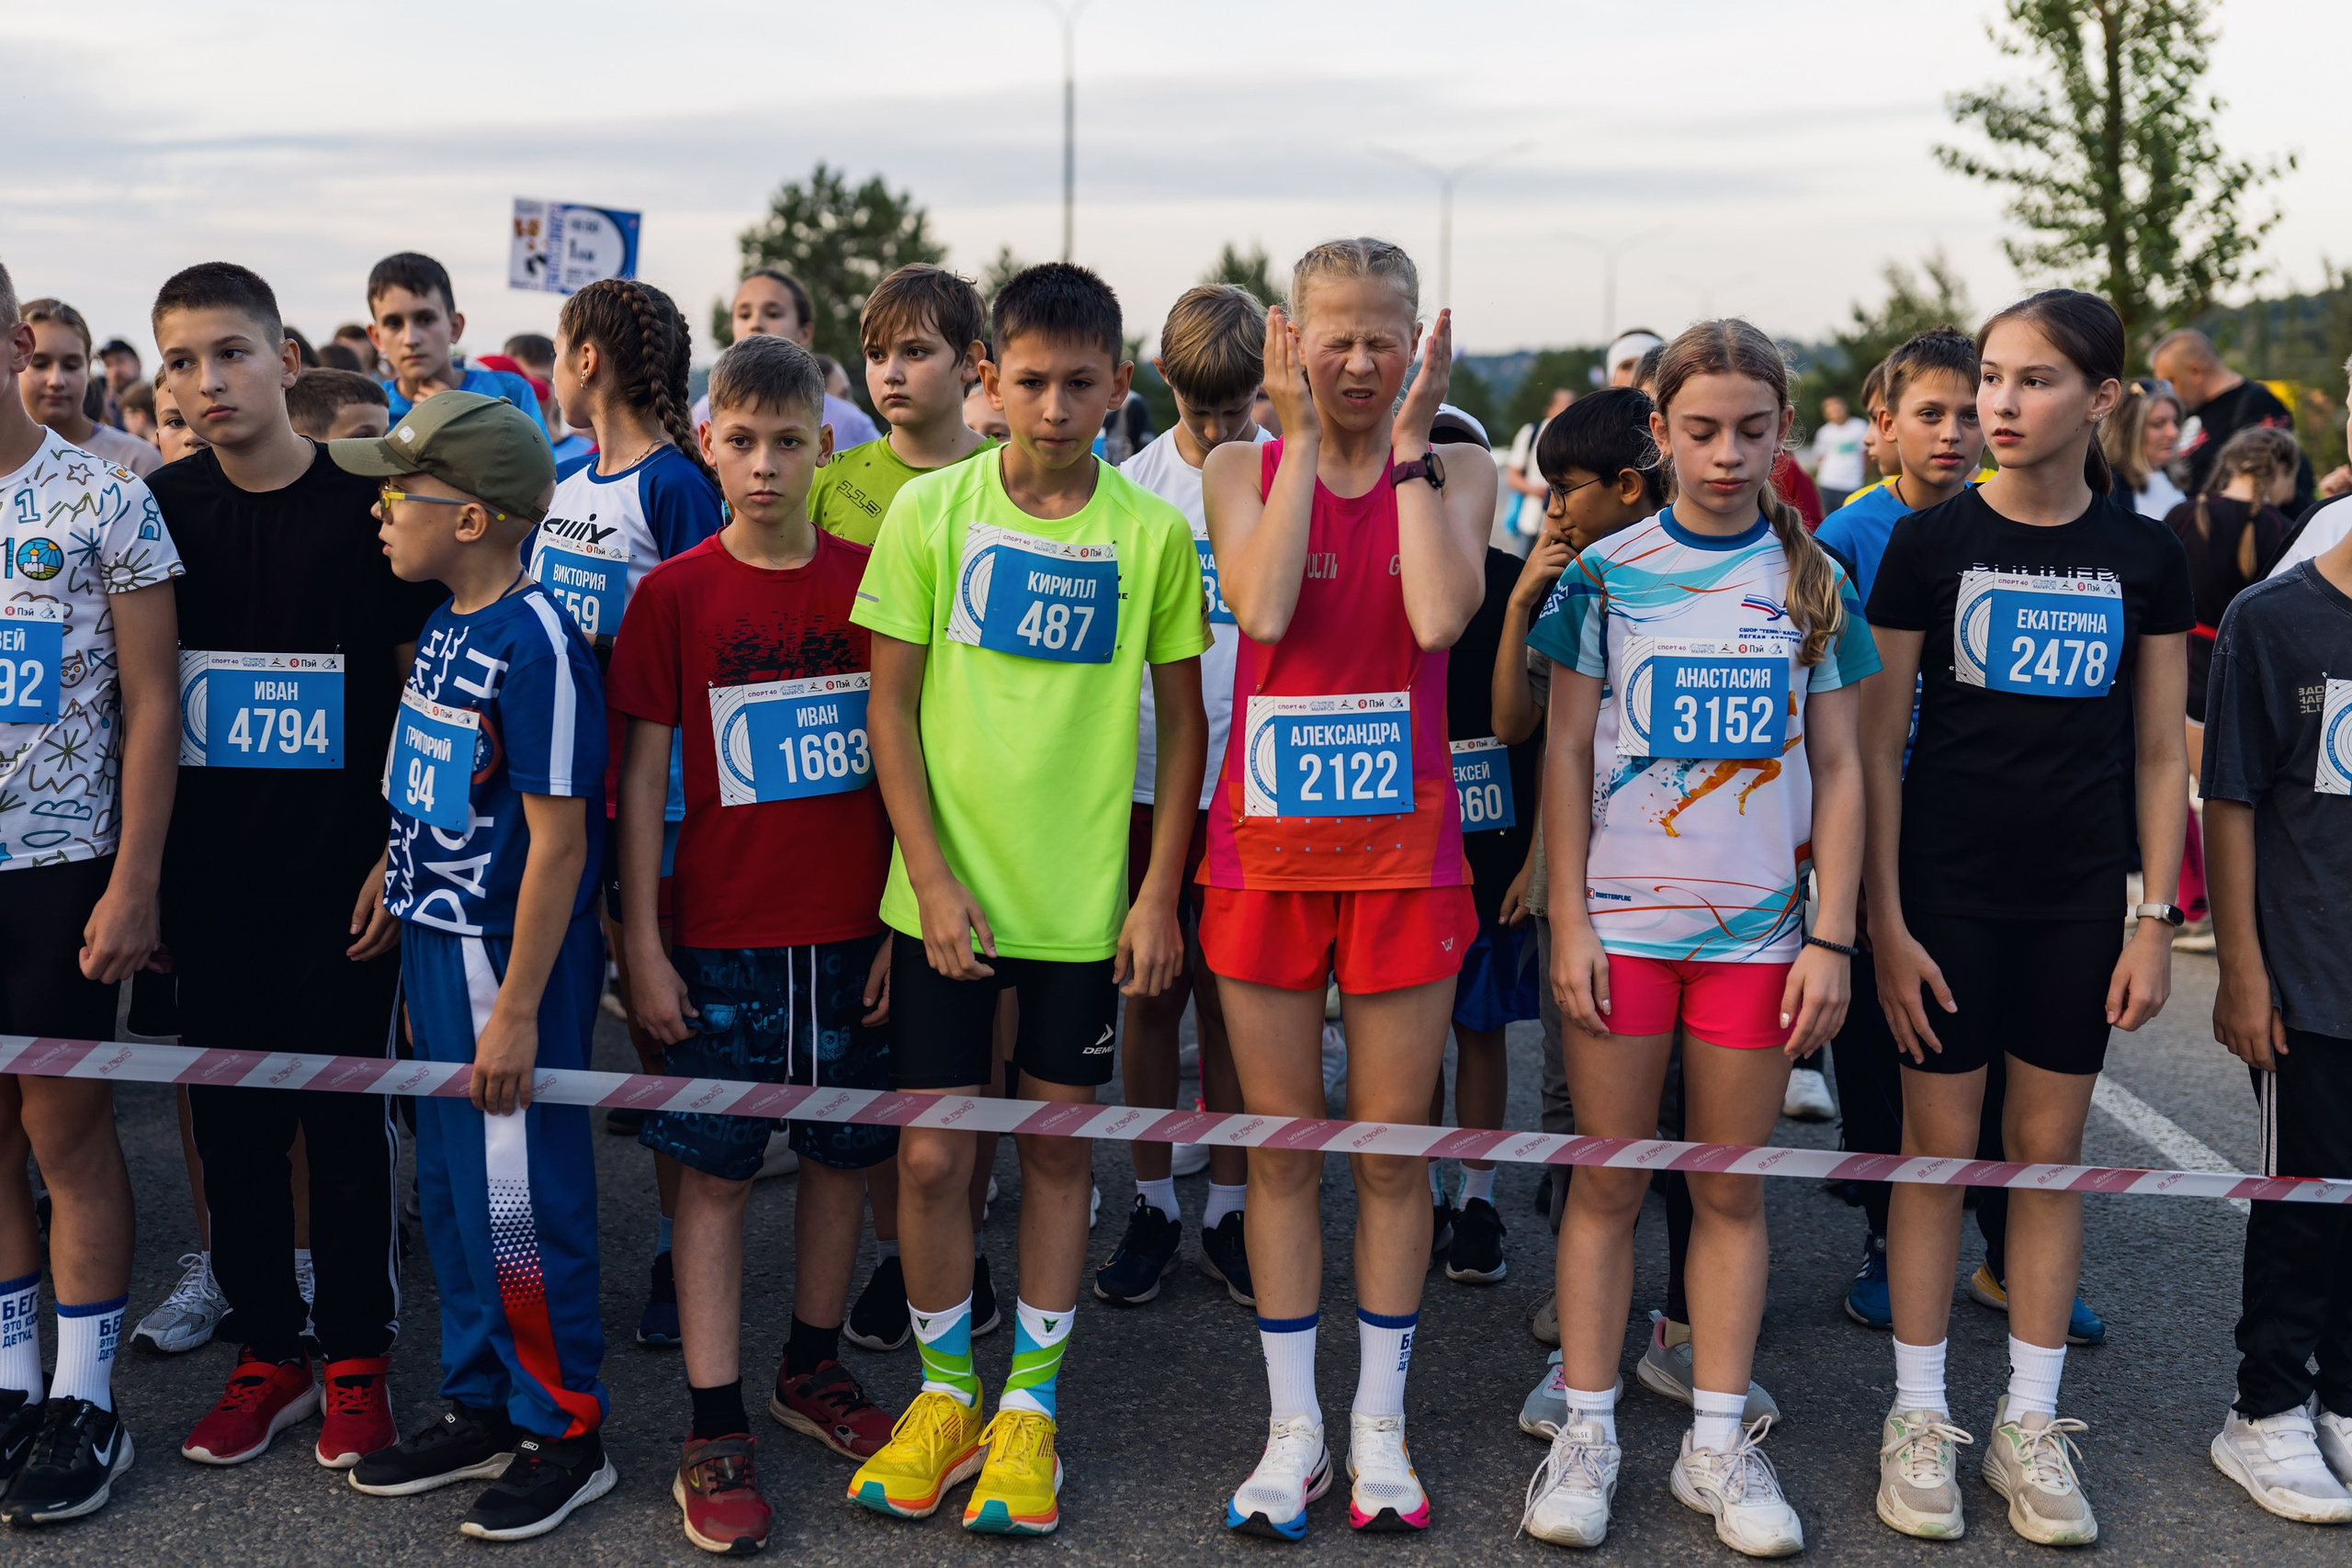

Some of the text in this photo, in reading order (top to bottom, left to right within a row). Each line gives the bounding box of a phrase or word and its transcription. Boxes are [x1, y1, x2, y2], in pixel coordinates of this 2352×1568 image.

[594, 547, 605, 555] Пэй
[553, 564, 606, 592] ВИКТОРИЯ
[1027, 570, 1097, 599] КИРИЛЛ
[2087, 583, 2100, 592] Пэй
[17, 607, 34, 616] Пэй
[2017, 608, 2108, 634] ЕКАТЕРИНА
[1016, 600, 1095, 652] 487
[301, 659, 317, 668] Пэй
[2008, 636, 2109, 687] 2478
[836, 680, 851, 689] Пэй
[1676, 667, 1771, 688] АНАСТАСИЯ
[254, 681, 298, 701] ИВАН
[439, 709, 452, 719] Пэй
[796, 704, 839, 728] ИВАН
[1674, 695, 1773, 743] 3152
[228, 707, 329, 754] 4794
[1291, 722, 1400, 746] АЛЕКСАНДРА
[405, 725, 452, 762] ГРИГОРИЙ
[779, 728, 871, 783] 1683
[406, 757, 435, 812] 94
[1299, 750, 1398, 801] 2122
[3, 1329, 32, 1348] ДЕТКА
[4, 1320, 21, 1334] ЭТО
